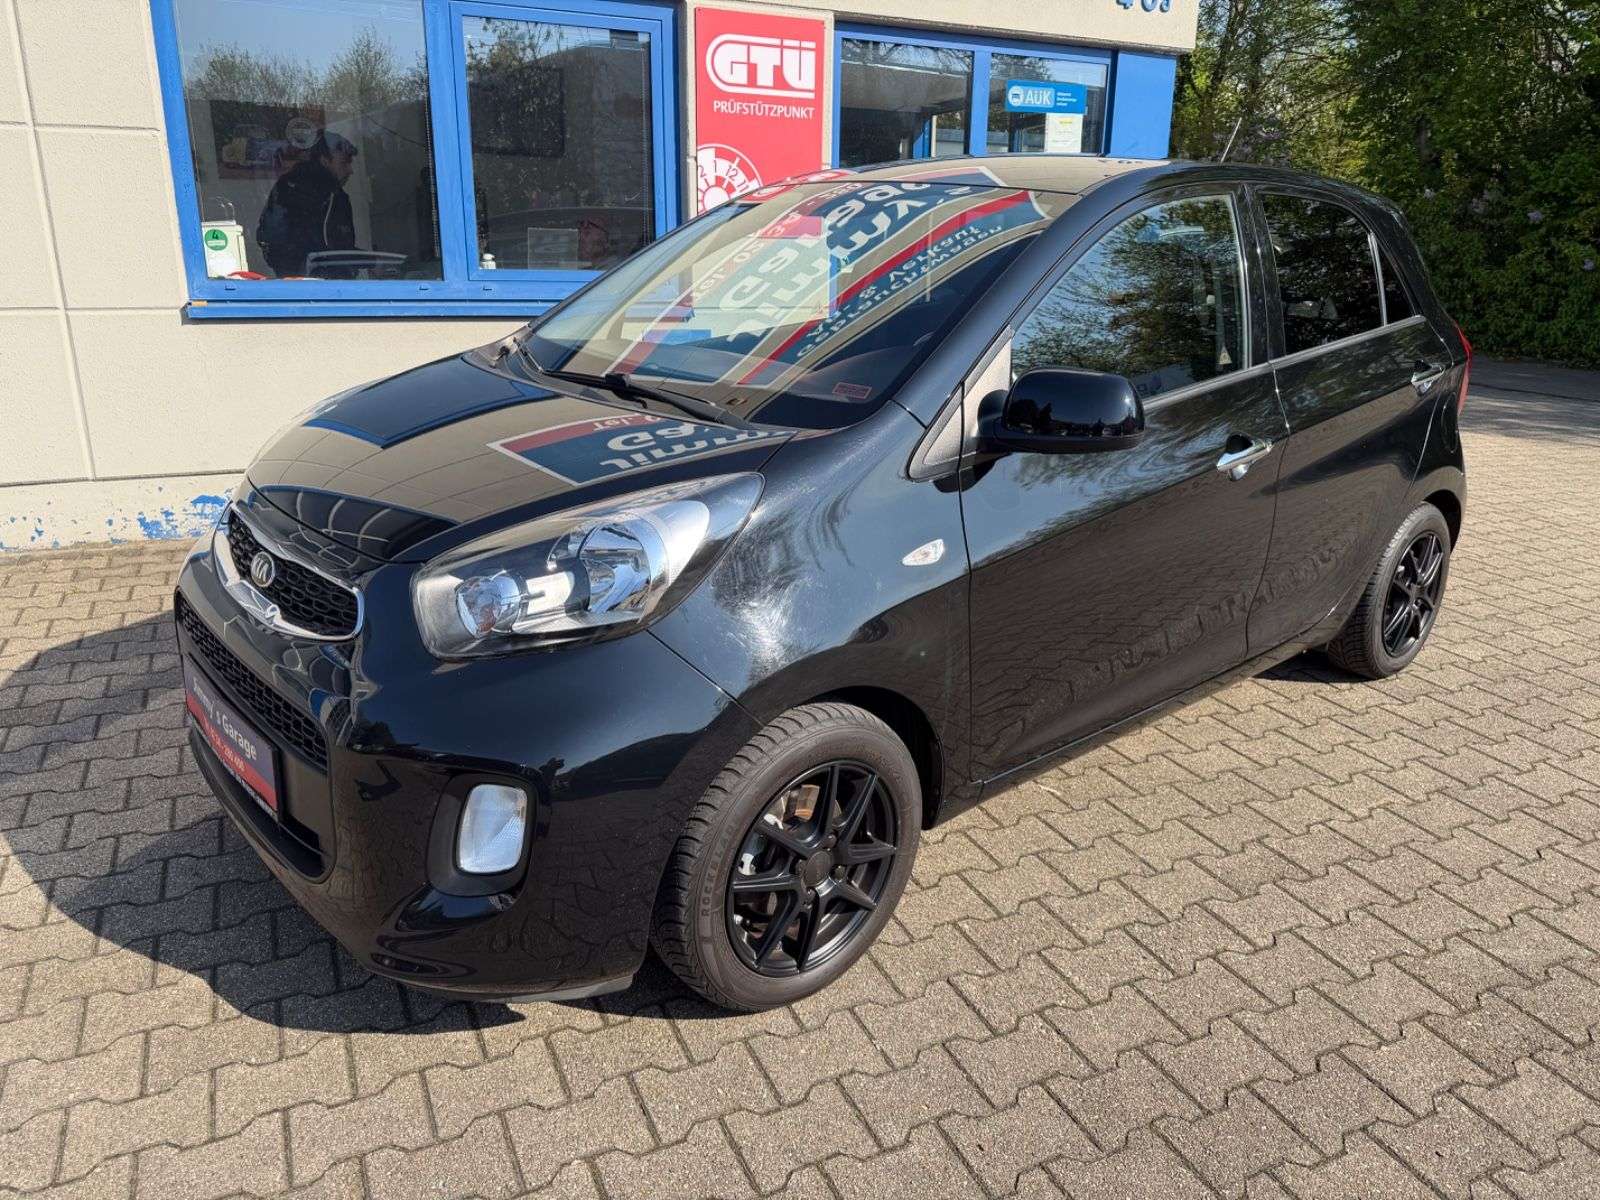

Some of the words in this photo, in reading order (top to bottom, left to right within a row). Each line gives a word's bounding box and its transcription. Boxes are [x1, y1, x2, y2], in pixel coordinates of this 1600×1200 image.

[706, 33, 816, 98] GTÜ
[713, 99, 815, 120] PRÜFSTÜTZPUNKT
[725, 165, 738, 181] 12
[737, 179, 750, 193] 11
[222, 713, 257, 760] Garage
